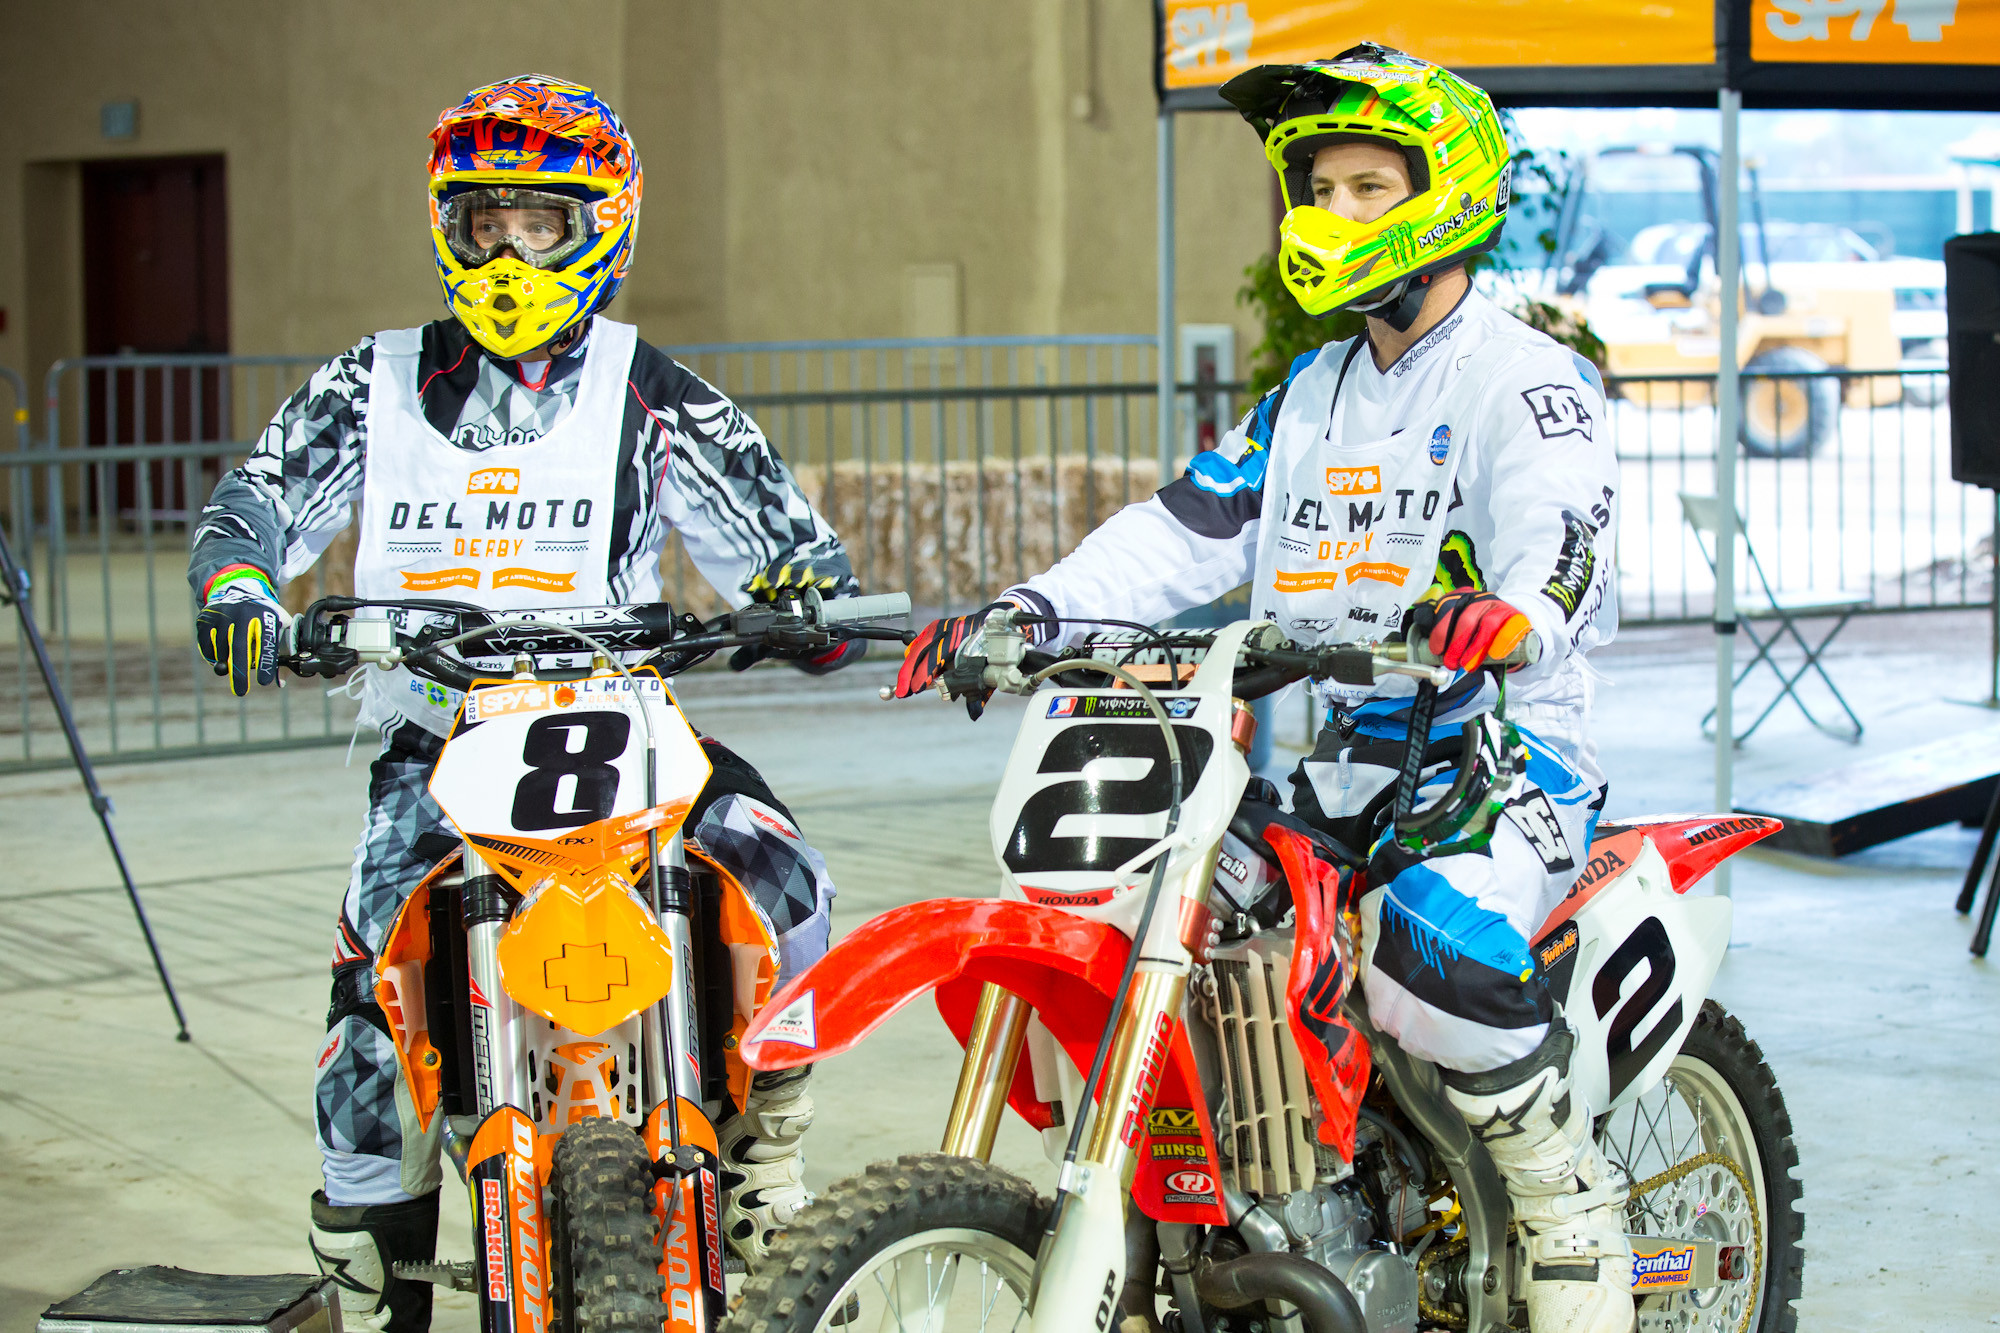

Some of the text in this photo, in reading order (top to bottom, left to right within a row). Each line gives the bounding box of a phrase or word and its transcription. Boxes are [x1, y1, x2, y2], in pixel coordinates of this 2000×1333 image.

[475, 149, 542, 161] FLY
[1418, 196, 1489, 249] MONSTER
[1434, 217, 1482, 252] ENERGY
[1393, 356, 1413, 378] Troy
[1410, 345, 1430, 362] Lee
[389, 498, 593, 530] DEL MOTO
[454, 538, 523, 557] DERBY
[482, 605, 643, 638] VORTEX
[1348, 606, 1378, 624] KTM
[485, 629, 644, 655] VORTEX
[410, 679, 425, 696] BE
[588, 694, 628, 703] DERBY
[604, 679, 660, 692] MOTO
[468, 695, 476, 720] 2012
[511, 711, 631, 832] 8
[1002, 724, 1214, 874] 2
[565, 837, 586, 846] FX
[1687, 817, 1767, 846] DUNLOP
[1037, 895, 1100, 906] HONDA
[1541, 931, 1577, 966] Twin Air
[1592, 915, 1684, 1106] 2
[1120, 1010, 1175, 1157] SHOWA
[512, 1116, 544, 1333] DUNLOP
[658, 1107, 695, 1326] DUNLP
[700, 1167, 723, 1294] BRAKING
[482, 1179, 507, 1302] BRAKING
[1642, 1273, 1689, 1285] CHAINWHEELS
